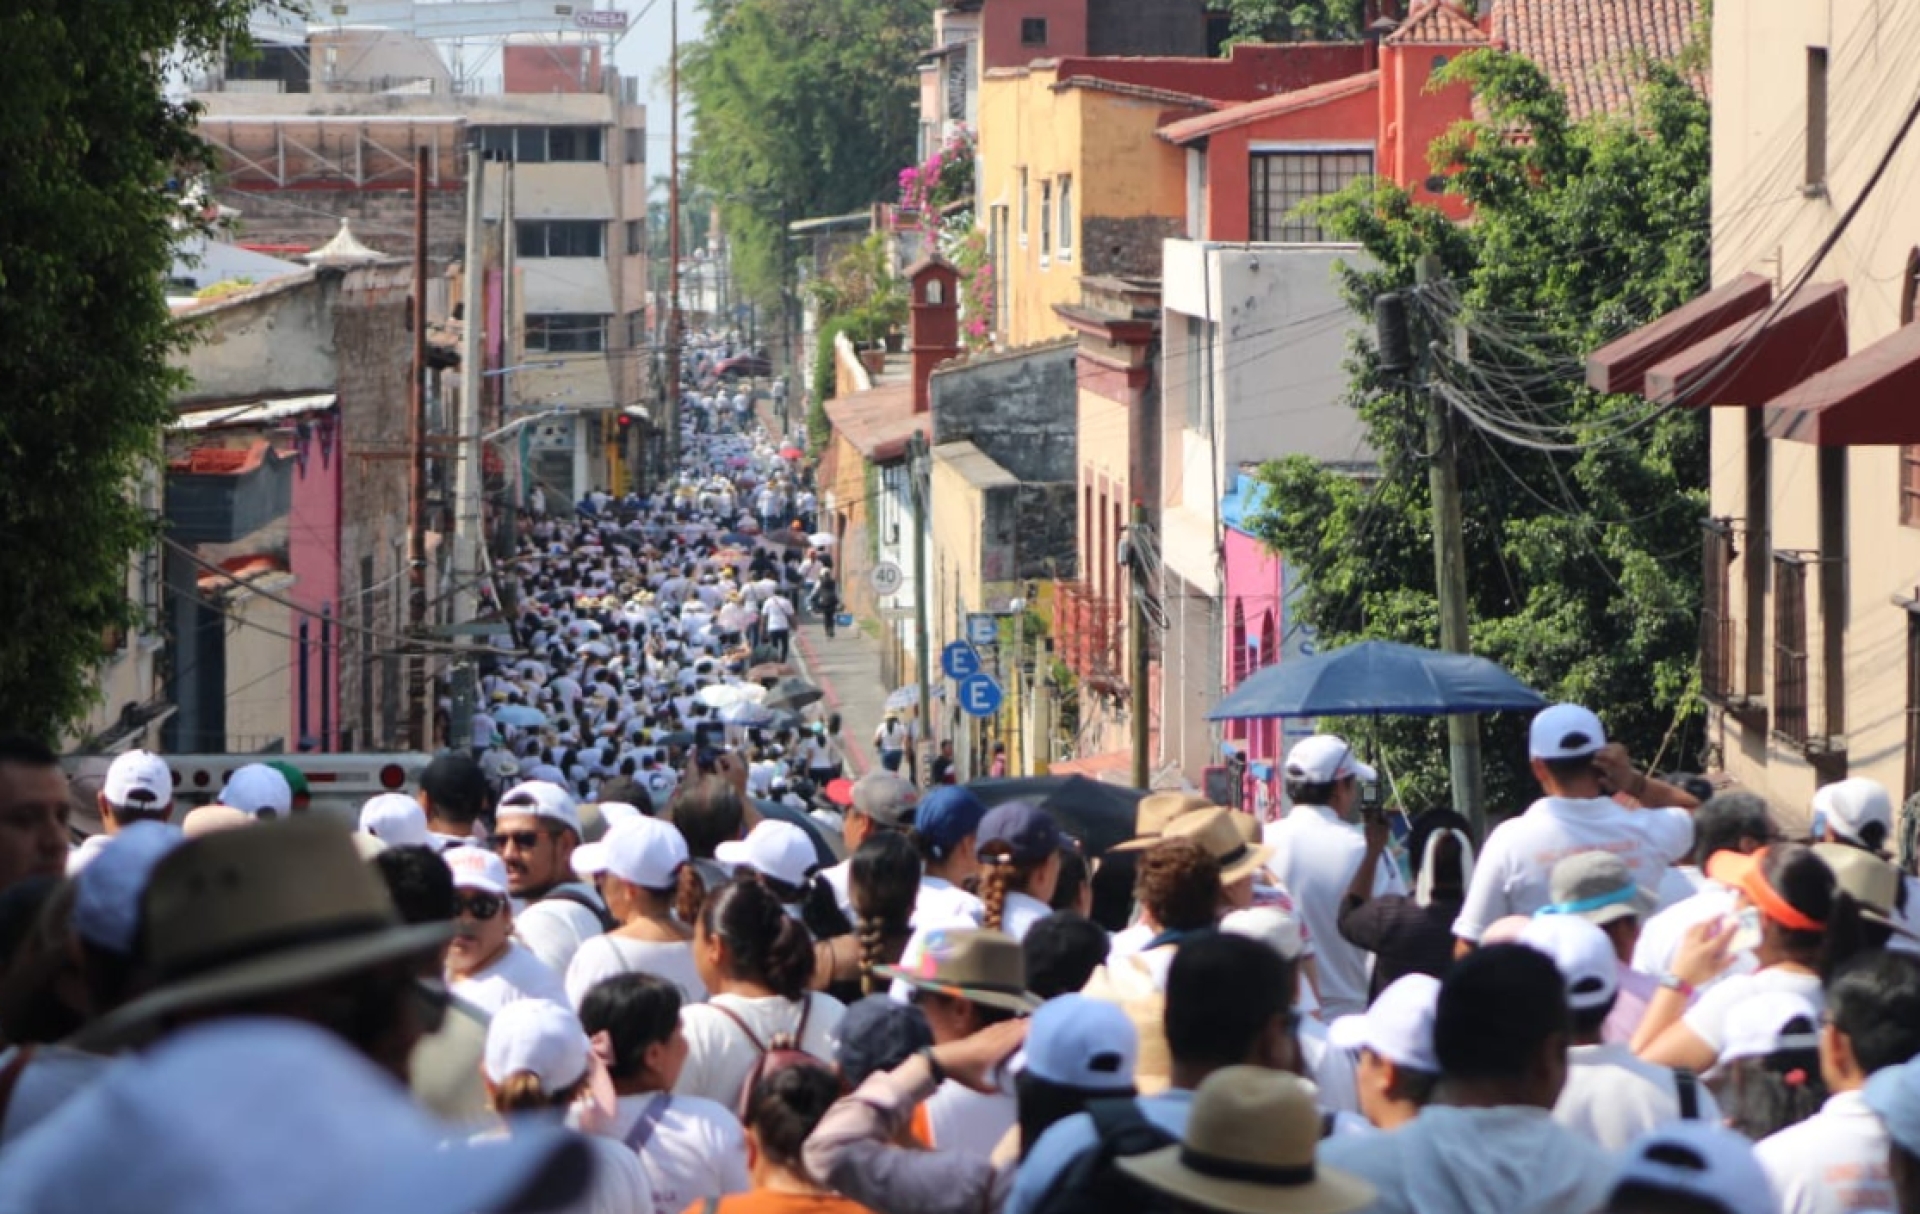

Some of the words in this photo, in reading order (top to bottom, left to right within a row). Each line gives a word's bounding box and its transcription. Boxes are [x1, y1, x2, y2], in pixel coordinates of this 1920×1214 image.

[876, 568, 896, 583] 40
[953, 648, 970, 673] E
[970, 682, 990, 708] E
